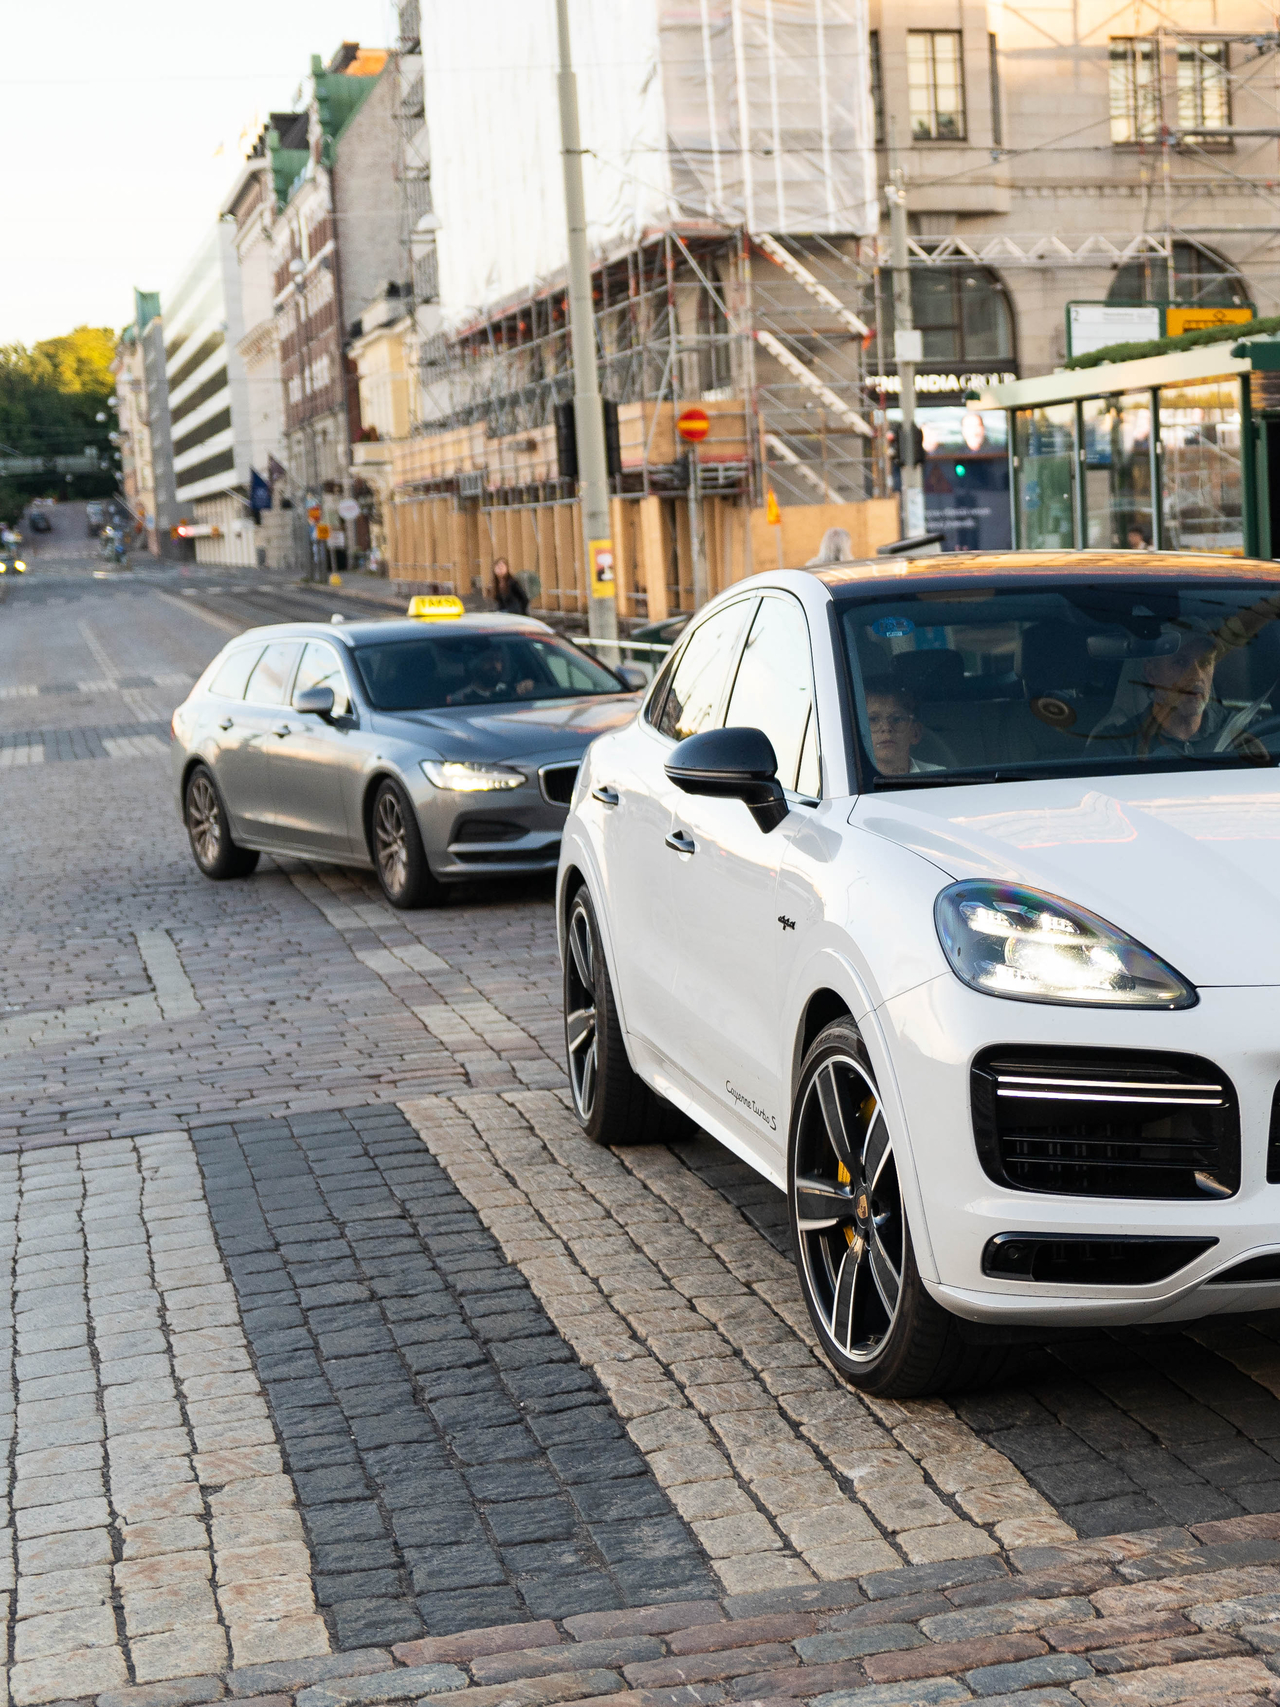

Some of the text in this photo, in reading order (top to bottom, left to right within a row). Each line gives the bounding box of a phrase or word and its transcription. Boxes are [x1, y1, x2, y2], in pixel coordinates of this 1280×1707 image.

[726, 1080, 777, 1131] Cayenne Turbo S
